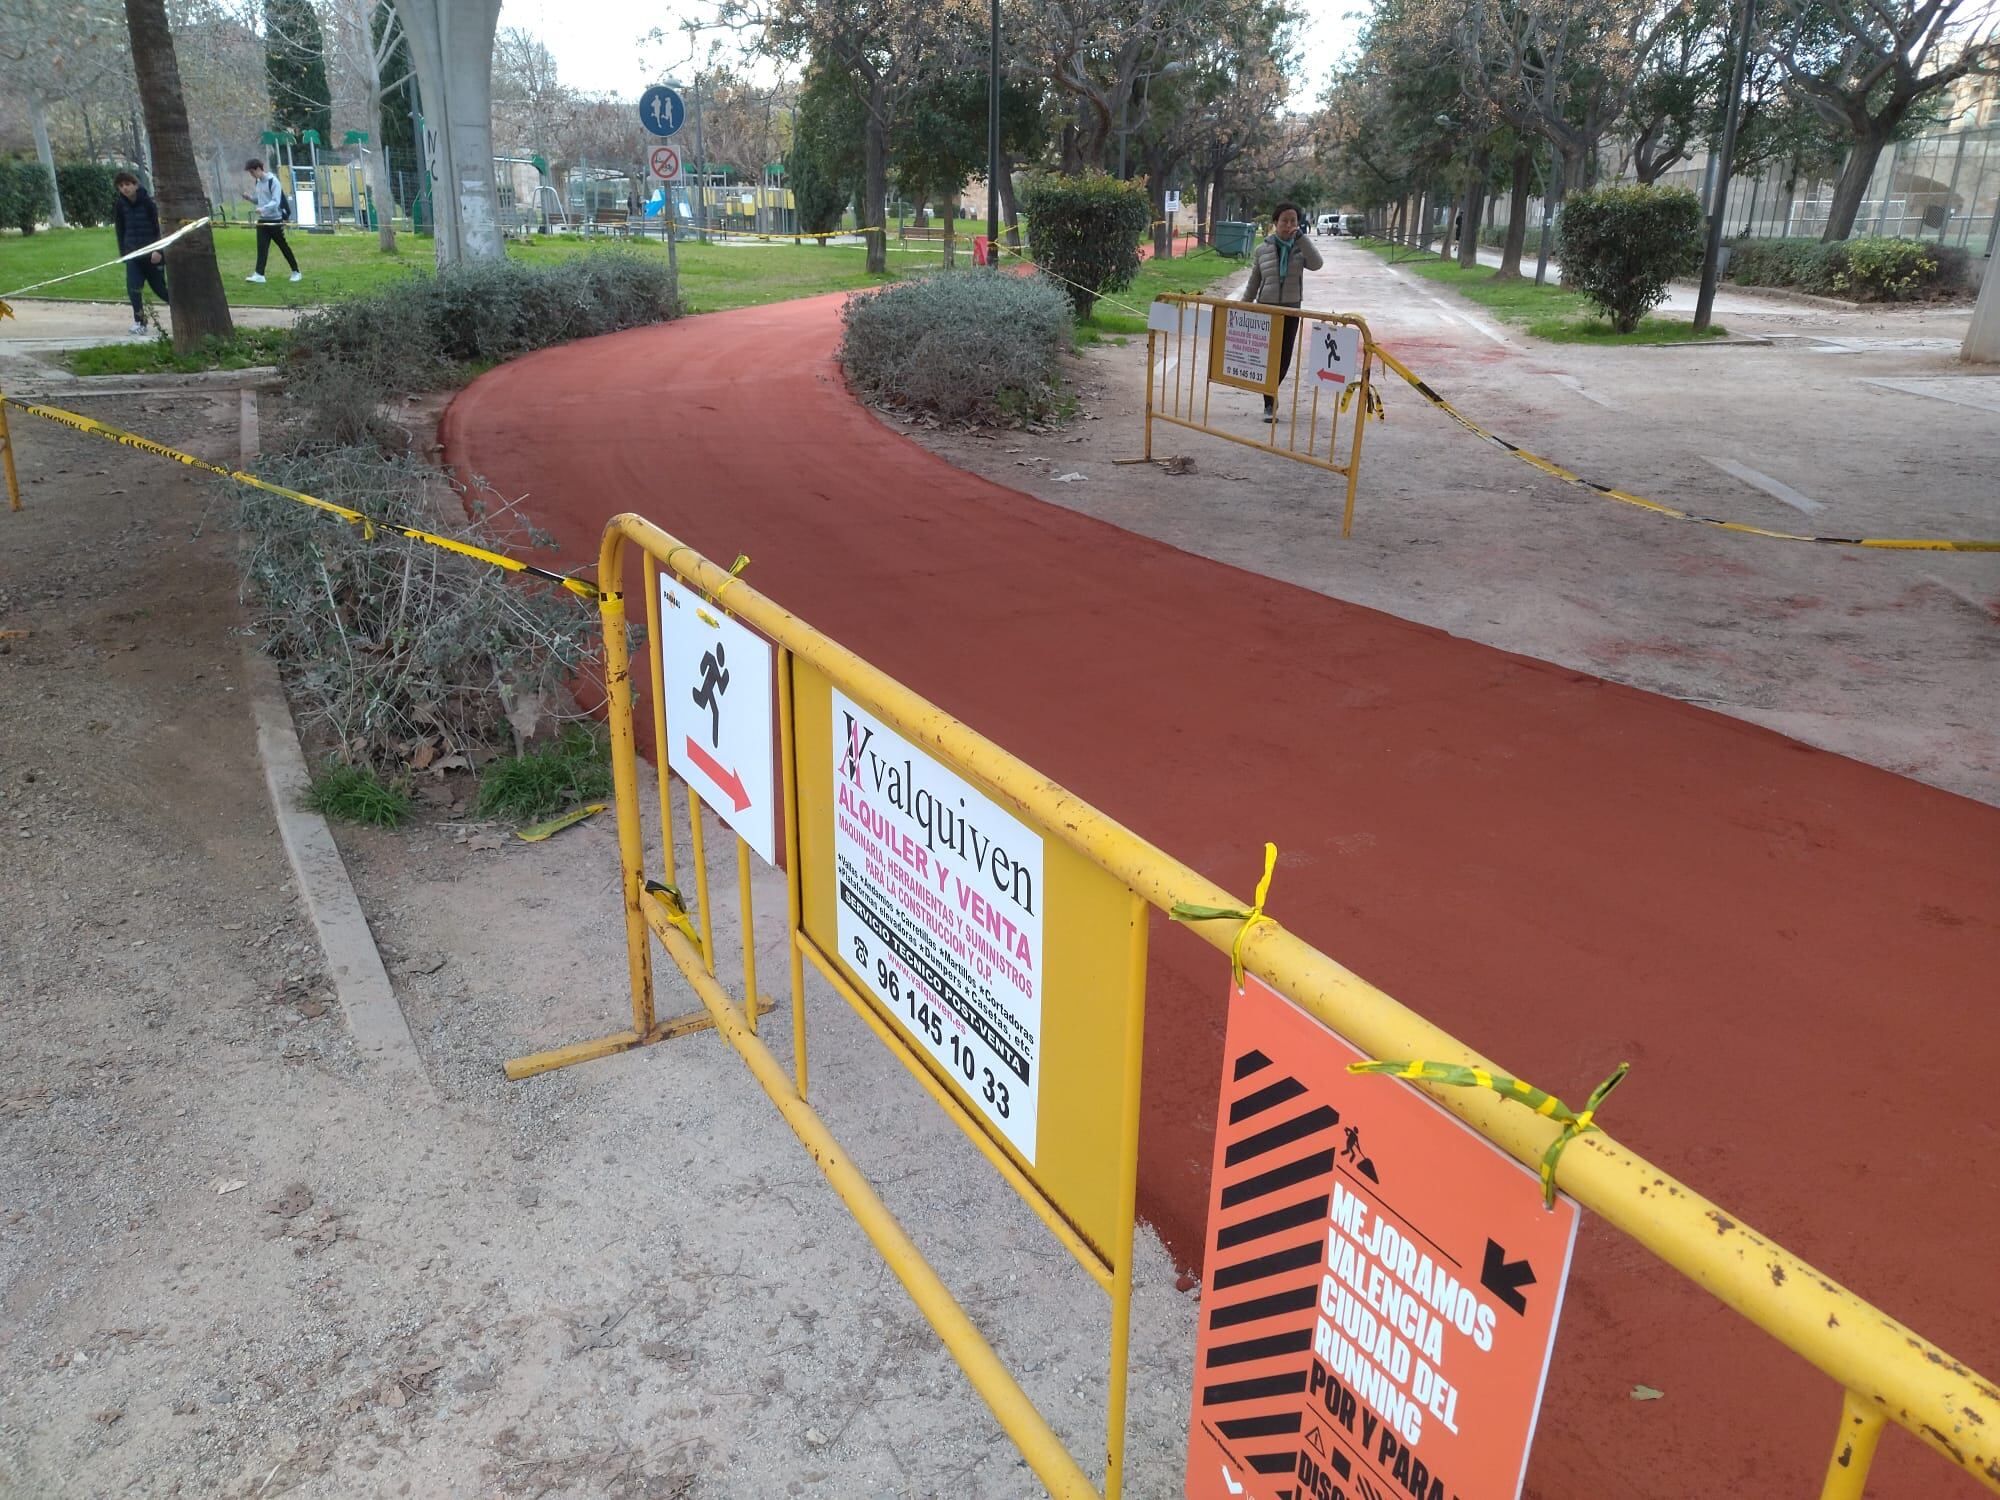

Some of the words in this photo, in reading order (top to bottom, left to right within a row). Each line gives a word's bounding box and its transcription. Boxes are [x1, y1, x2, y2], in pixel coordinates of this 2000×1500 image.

[1235, 313, 1270, 332] valquiven
[838, 782, 929, 880] ALQUILER
[934, 859, 950, 893] Y
[955, 876, 1033, 972] VENTA
[838, 812, 886, 873] MAQUINARIA,
[887, 856, 954, 927] HERRAMIENTAS
[956, 915, 963, 934] Y
[965, 924, 1033, 999] SUMINISTROS
[869, 750, 1035, 917] valquiven
[844, 890, 890, 942] SERVICIO
[892, 937, 942, 991] TECNICO
[944, 985, 1021, 1074] POST-VENTA
[865, 857, 885, 888] PARA
[886, 875, 897, 898] LA
[898, 887, 966, 960] CONSTRUCCION
[968, 947, 975, 966] Y
[976, 957, 993, 986] O.P.
[879, 907, 918, 947] elevadoras
[1014, 1035, 1034, 1060] etc.
[887, 951, 967, 1036] www.valquiven.es
[877, 958, 900, 1002] 96
[907, 989, 943, 1046] 145
[951, 1034, 975, 1081] 10
[983, 1066, 1010, 1120] 33
[1327, 1228, 1443, 1367] VALENCIA
[1330, 1181, 1497, 1353] MEJORAMOS
[1309, 1357, 1357, 1434] POR
[1361, 1405, 1378, 1450] Y
[1314, 1315, 1423, 1446] RUNNING
[1321, 1274, 1411, 1384] CIUDAD
[1411, 1356, 1459, 1436] DEL
